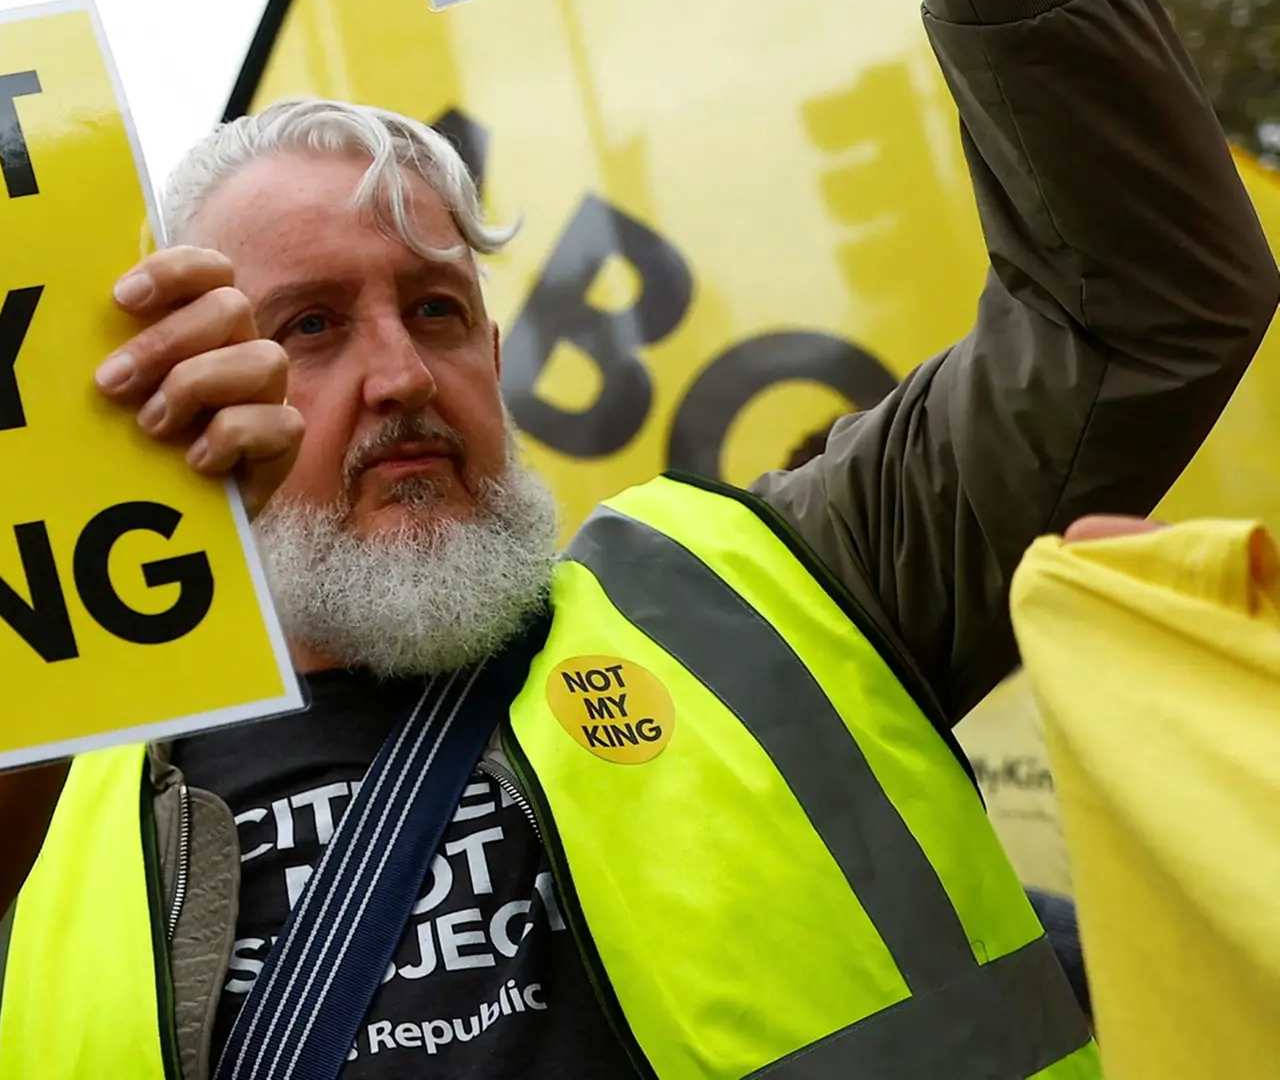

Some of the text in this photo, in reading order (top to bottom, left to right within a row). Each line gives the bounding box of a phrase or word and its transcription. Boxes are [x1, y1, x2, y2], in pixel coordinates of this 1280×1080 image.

[560, 664, 626, 693] NOT
[583, 693, 628, 720] MY
[581, 718, 663, 748] KING
[367, 978, 548, 1056] Republic
